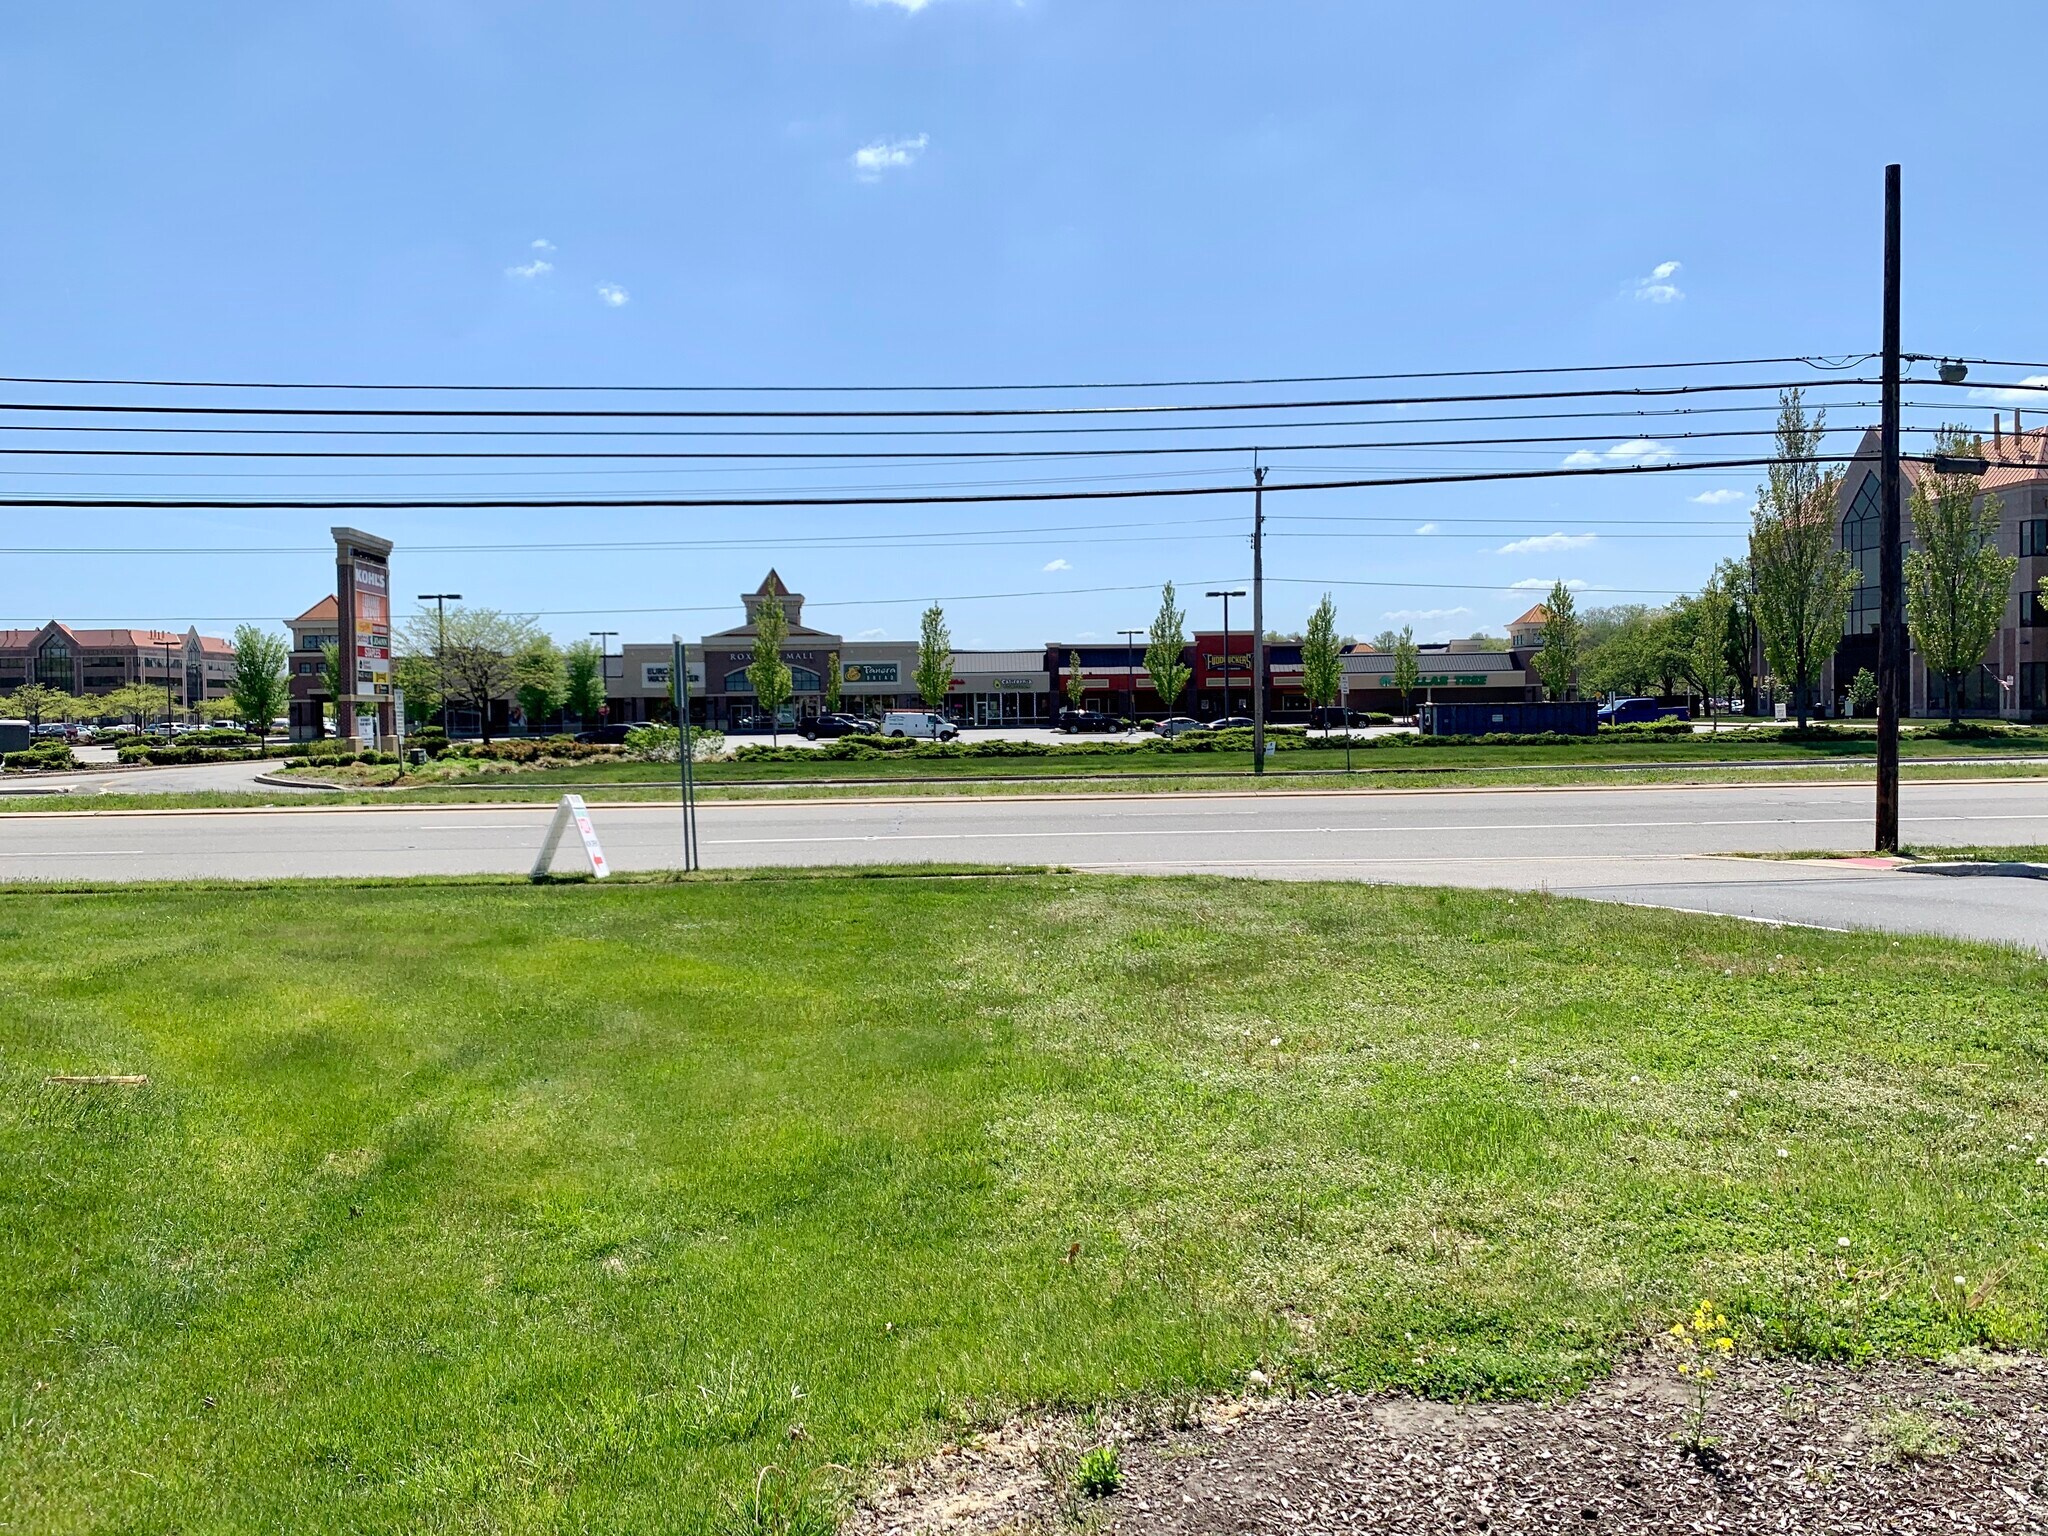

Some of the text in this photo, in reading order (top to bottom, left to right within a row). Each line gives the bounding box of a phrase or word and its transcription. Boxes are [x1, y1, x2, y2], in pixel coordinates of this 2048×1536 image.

[355, 569, 386, 588] KOHL'S
[364, 647, 381, 658] STAPLES
[786, 652, 814, 660] MALL
[862, 665, 896, 674] Panera
